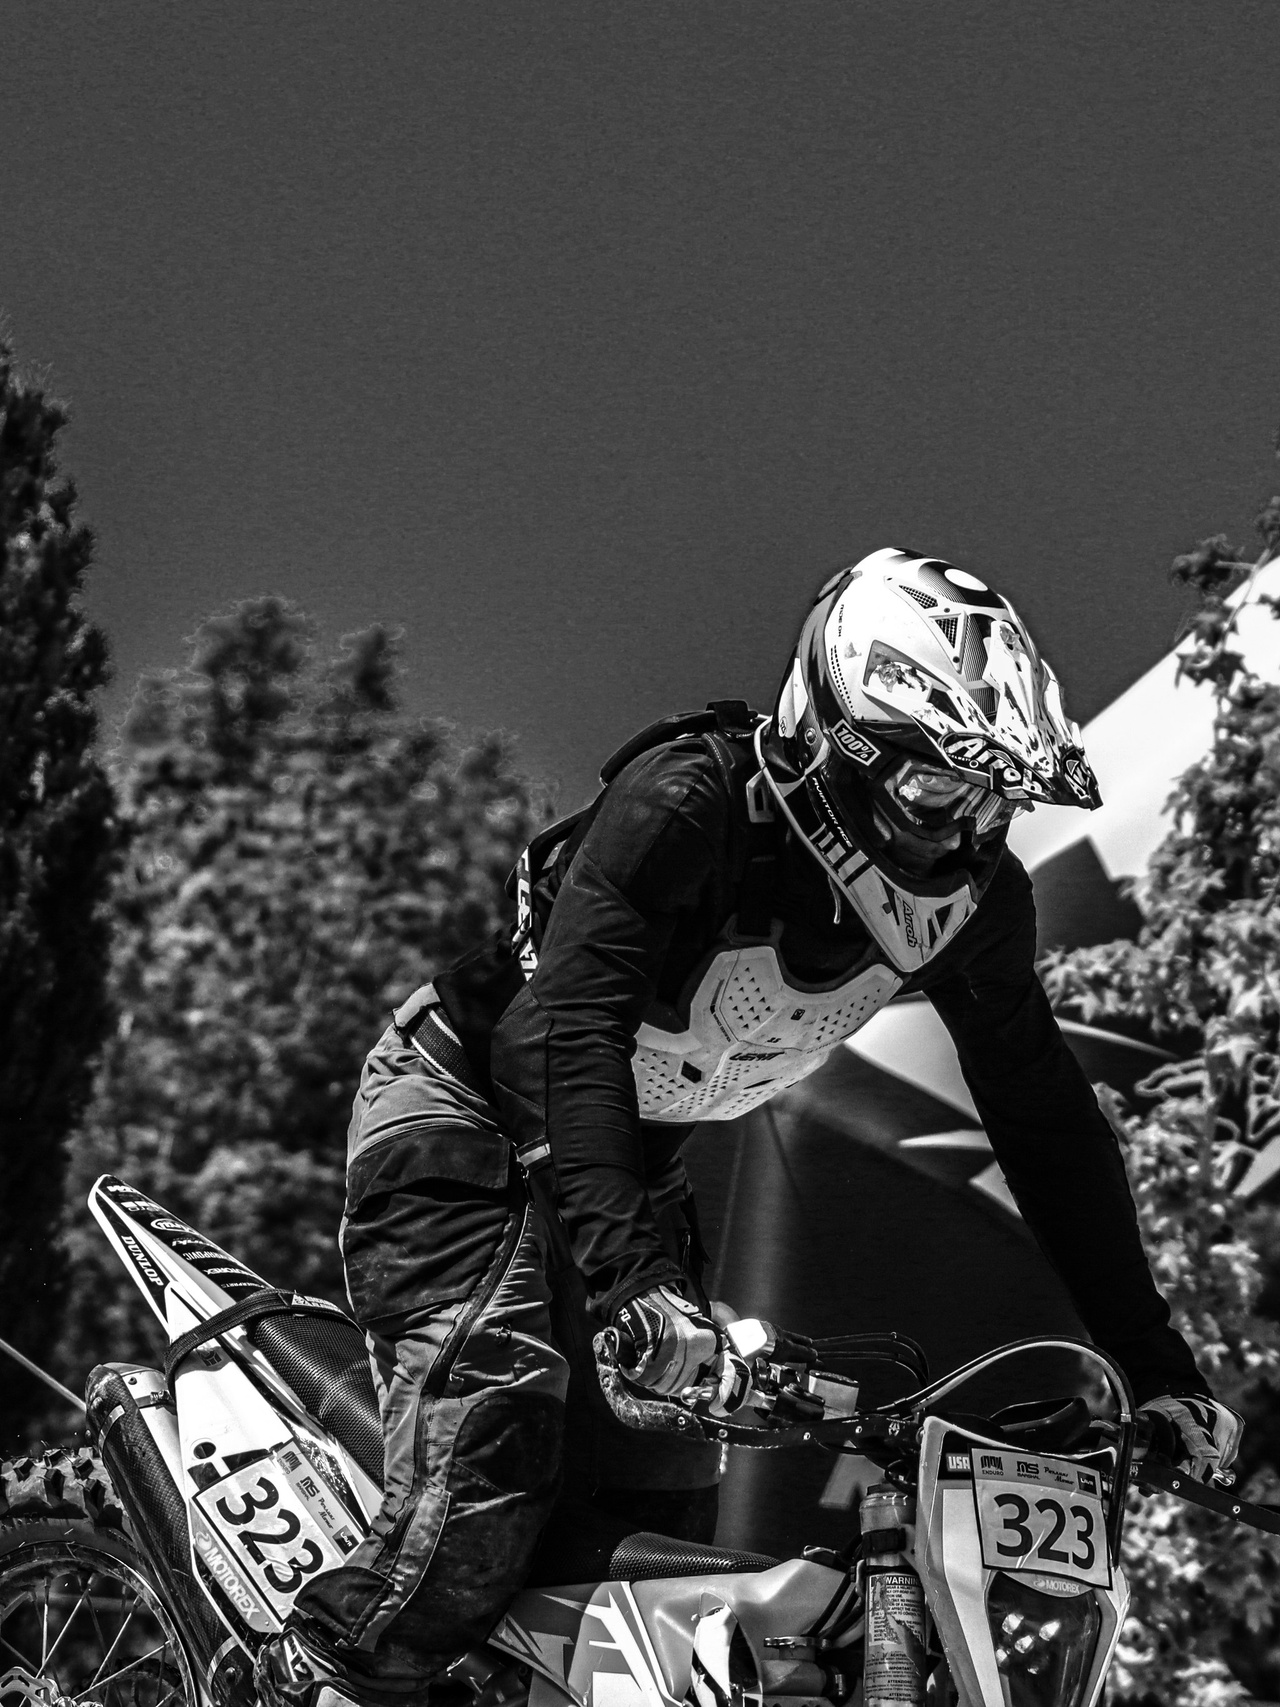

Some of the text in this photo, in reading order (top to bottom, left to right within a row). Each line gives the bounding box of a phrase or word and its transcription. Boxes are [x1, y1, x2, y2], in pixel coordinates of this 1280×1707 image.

[838, 723, 873, 760] 100%
[811, 775, 853, 848] AVIATOR ACE
[902, 900, 918, 948] Airoh
[121, 1235, 164, 1287] DUNLOP
[216, 1476, 324, 1594] 323
[993, 1492, 1096, 1570] 323
[204, 1550, 262, 1621] MOTOREX
[885, 1576, 921, 1586] WARNIN
[1045, 1578, 1081, 1596] MOTOREX
